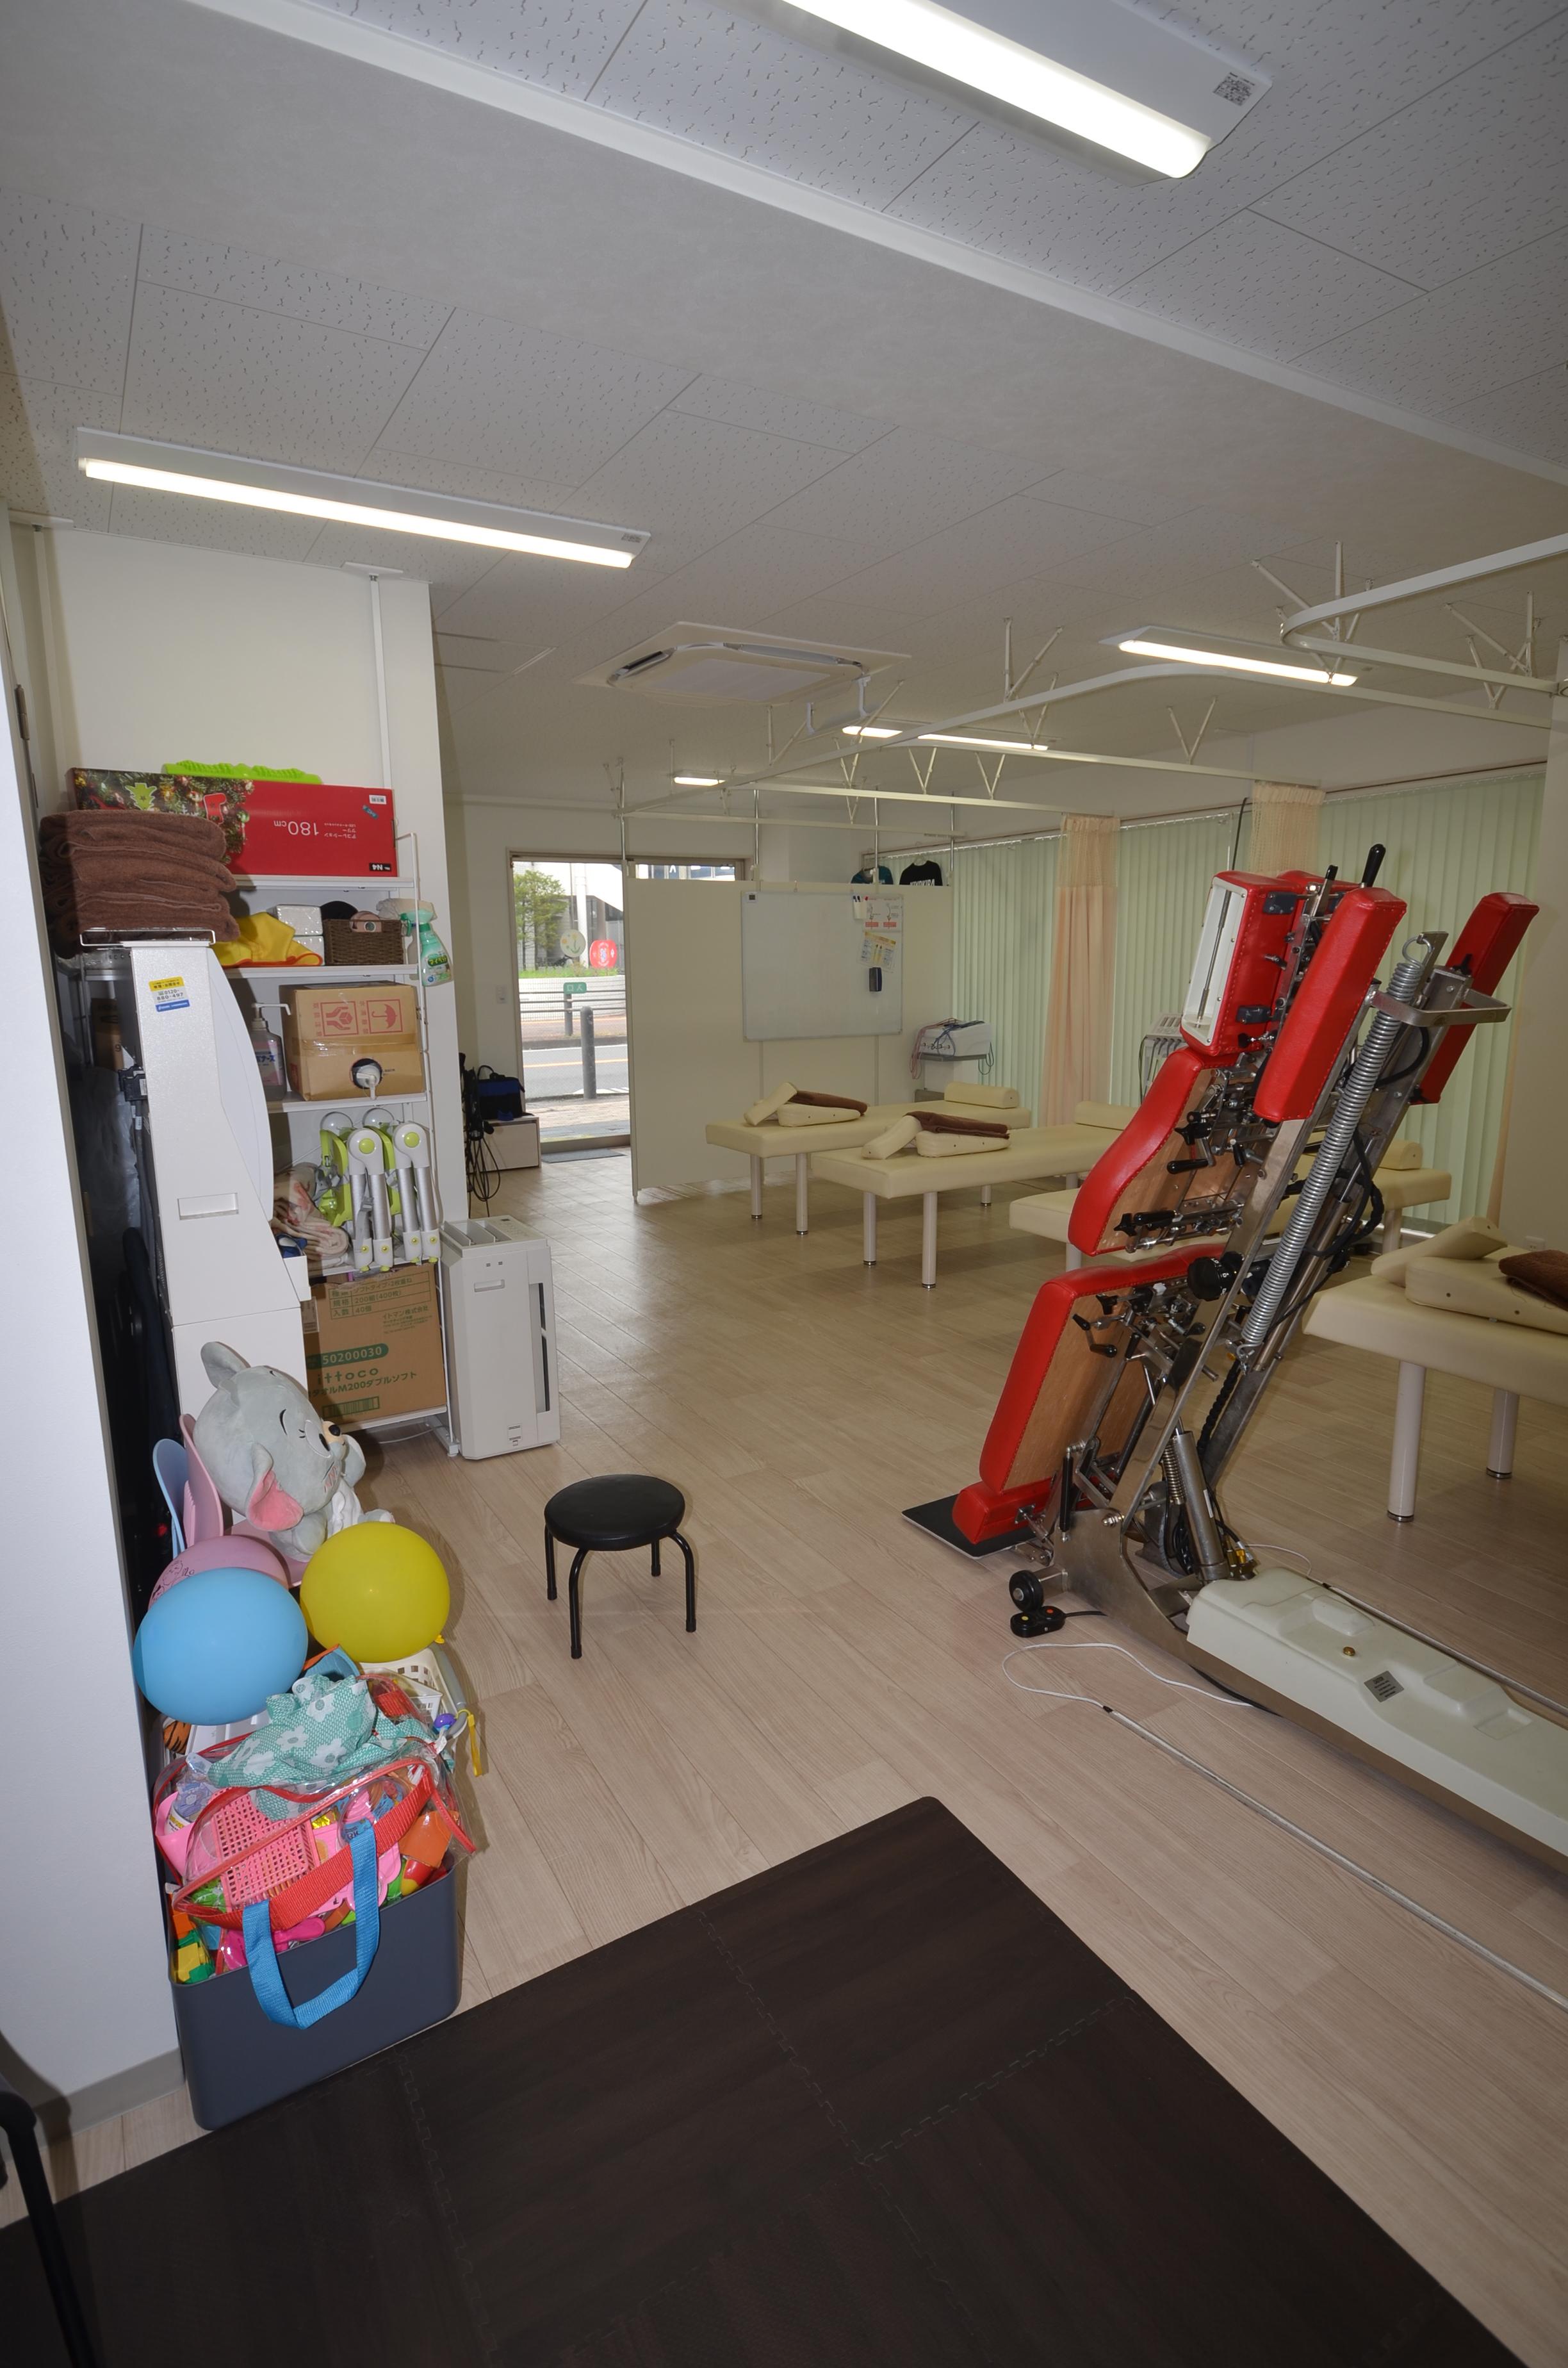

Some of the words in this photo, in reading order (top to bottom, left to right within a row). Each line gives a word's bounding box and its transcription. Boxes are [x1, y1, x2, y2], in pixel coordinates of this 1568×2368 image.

[274, 820, 319, 835] 180cm
[157, 992, 183, 1001] 880-497
[355, 1290, 401, 1303] 200組(400枚)
[382, 1305, 429, 1320] イトマン株式会社
[323, 1347, 382, 1365] 50200030
[316, 1368, 379, 1385] ittoco
